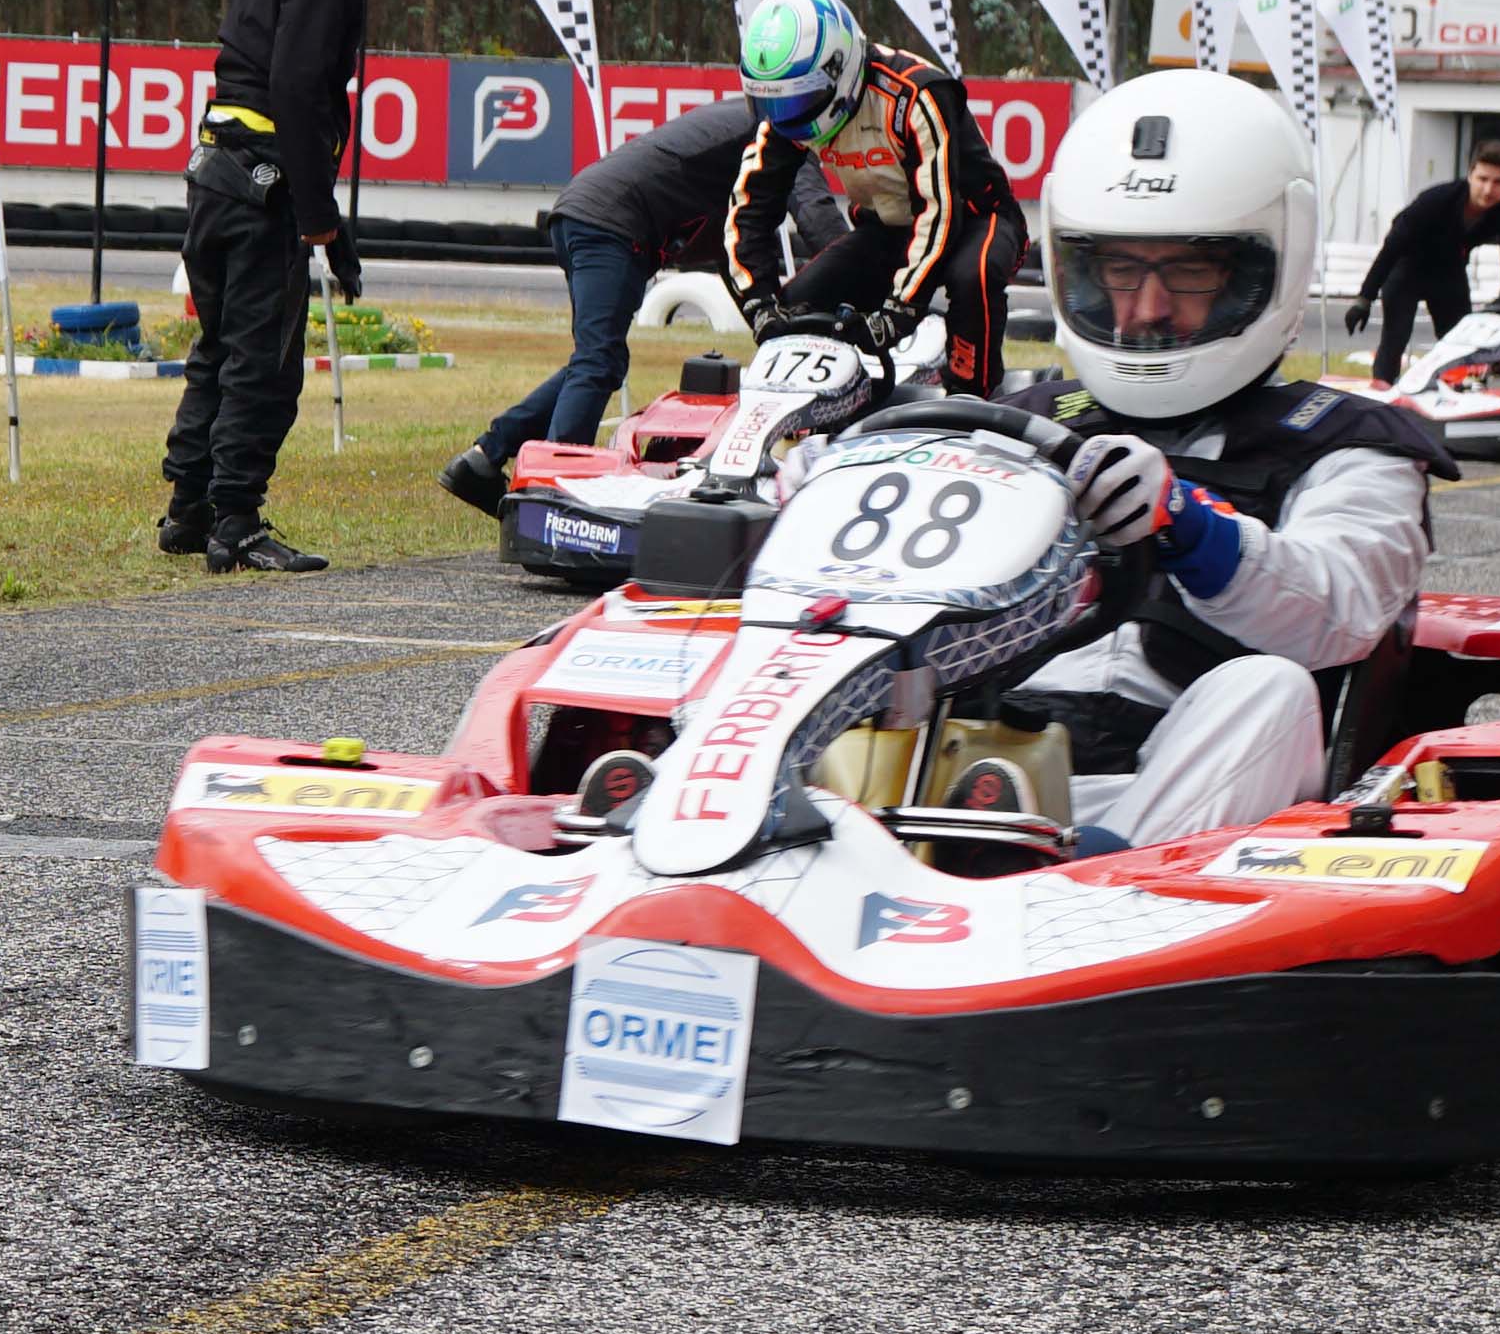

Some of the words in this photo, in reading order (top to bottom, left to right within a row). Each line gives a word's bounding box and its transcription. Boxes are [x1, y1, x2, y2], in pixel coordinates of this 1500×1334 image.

[1105, 169, 1179, 193] Arai
[763, 350, 837, 384] 175
[831, 471, 982, 570] 88
[291, 783, 425, 813] eni
[1326, 847, 1464, 879] eni
[583, 1009, 737, 1067] ORMEI
